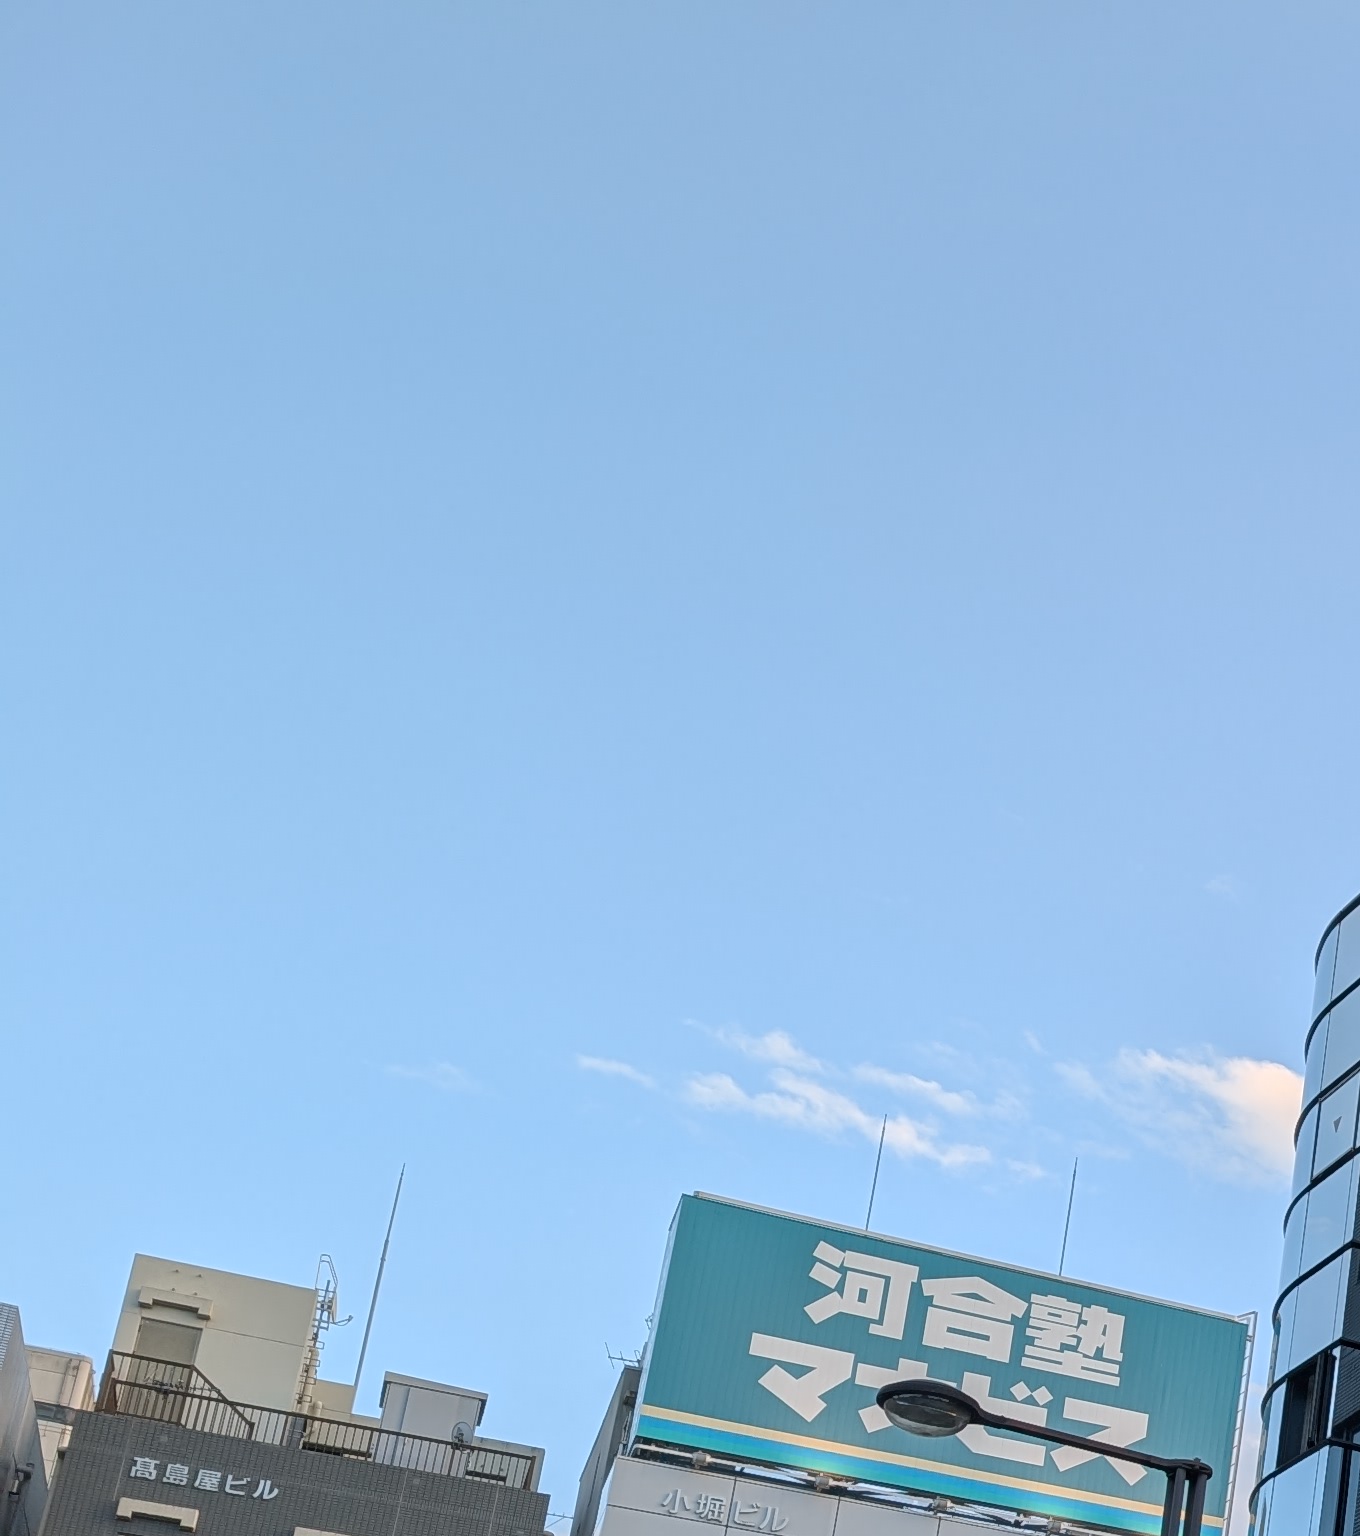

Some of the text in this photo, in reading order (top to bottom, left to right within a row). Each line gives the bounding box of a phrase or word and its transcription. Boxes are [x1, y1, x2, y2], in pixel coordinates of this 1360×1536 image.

[804, 1241, 1125, 1387] 河合塾
[661, 1488, 790, 1534] 小堀ビル
